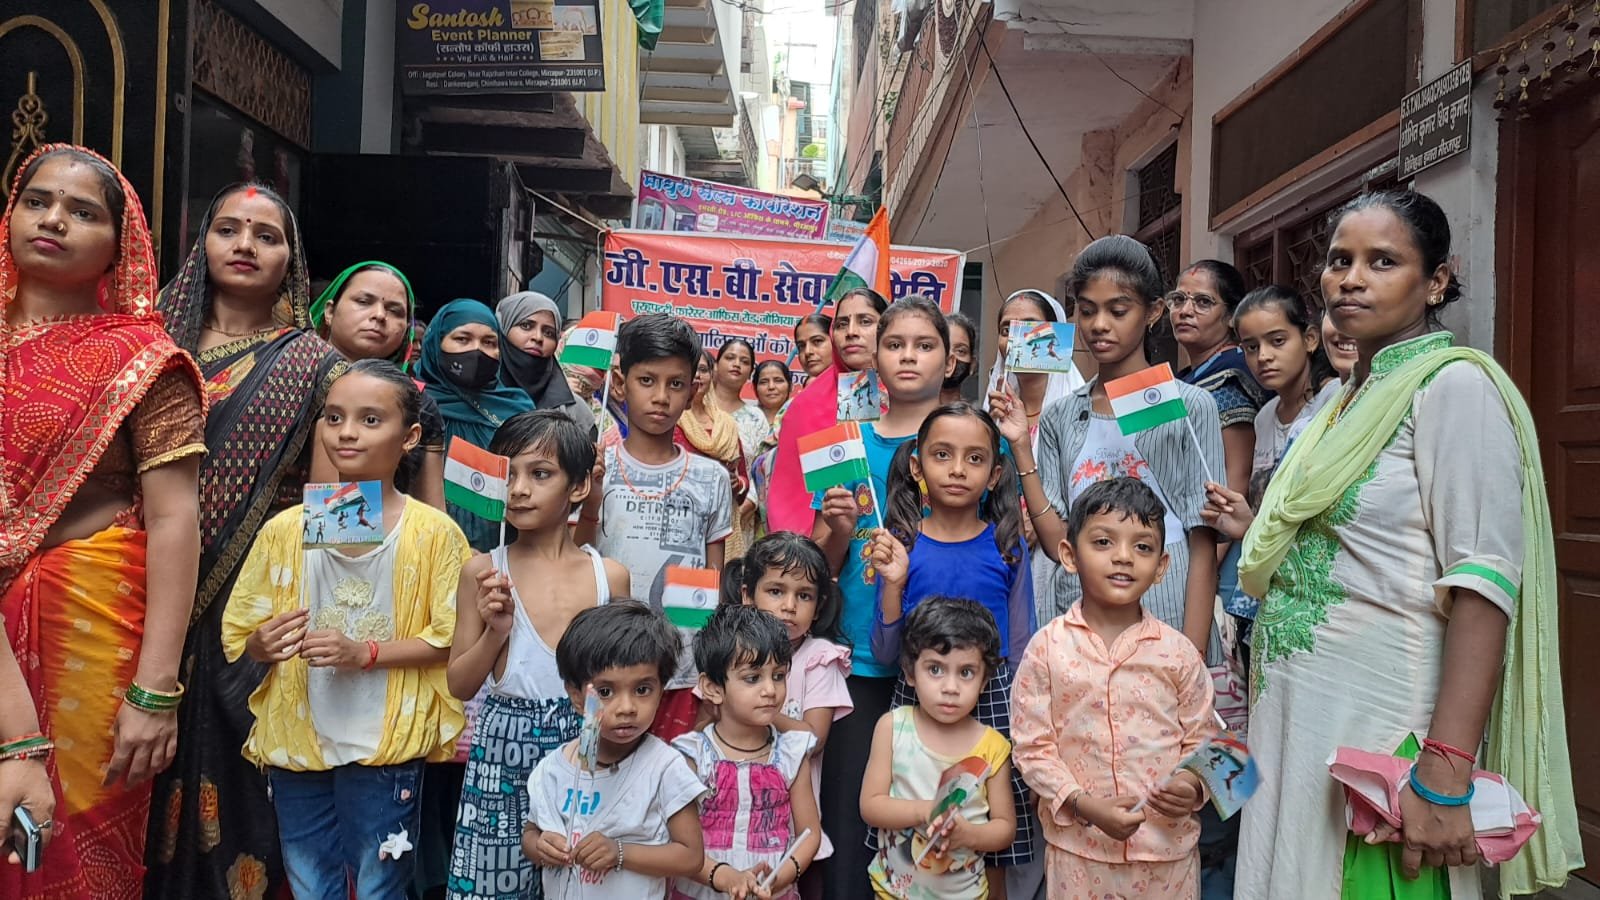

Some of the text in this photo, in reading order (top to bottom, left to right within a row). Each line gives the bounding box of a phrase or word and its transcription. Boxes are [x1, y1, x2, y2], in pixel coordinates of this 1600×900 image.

[407, 3, 505, 30] Santosh
[432, 30, 533, 41] Event Planner
[1419, 113, 1436, 146] कुमार
[1449, 95, 1468, 130] कुमार
[642, 173, 693, 200] माधुरी
[697, 183, 737, 205] सेल्स
[626, 500, 691, 518] DETROIT
[488, 713, 532, 741] HIP
[485, 737, 540, 769] HOP
[480, 799, 506, 811] R&B
[562, 788, 600, 815] Hi!
[497, 812, 509, 838] POP
[453, 847, 465, 878] R&B
